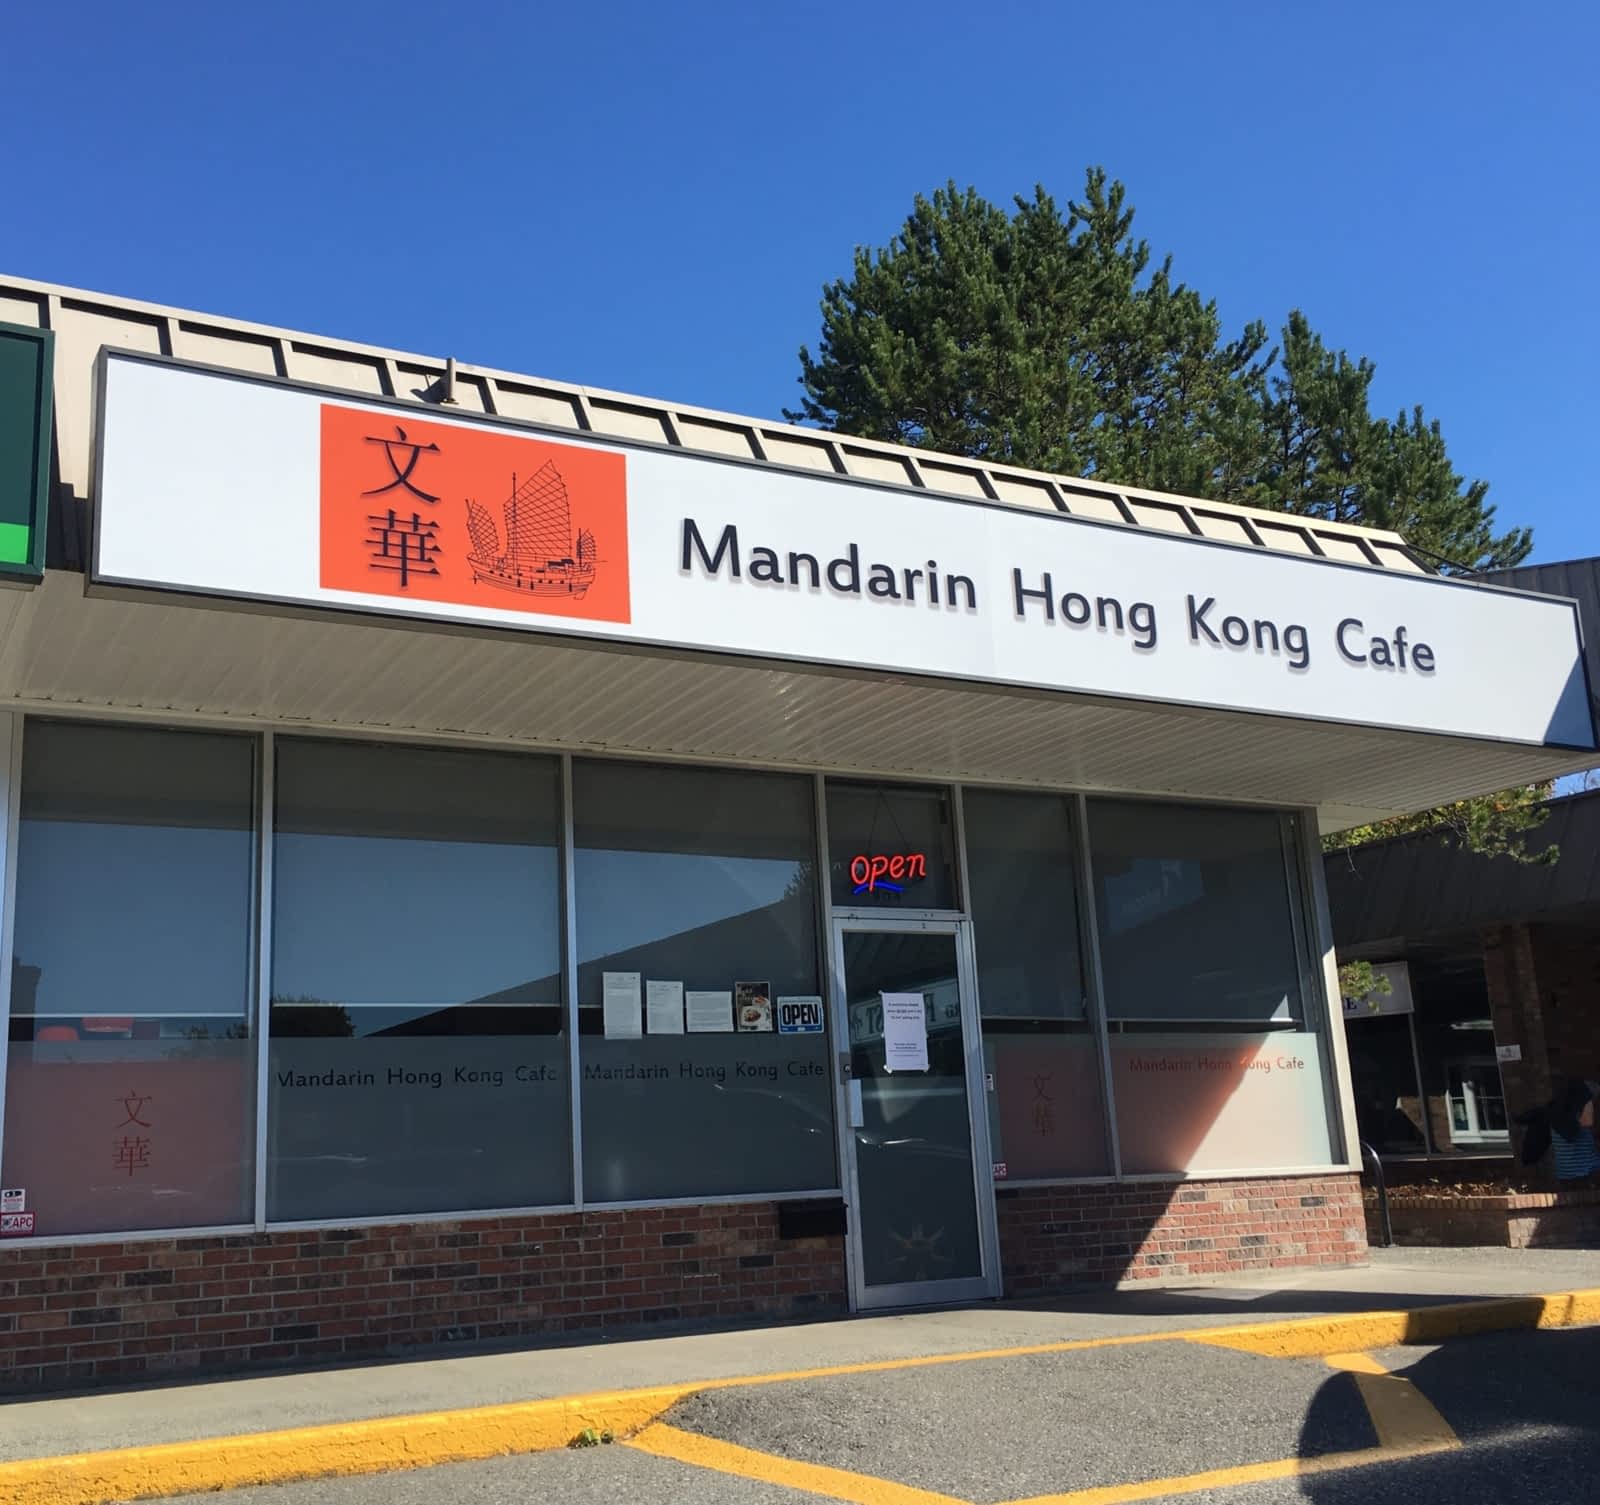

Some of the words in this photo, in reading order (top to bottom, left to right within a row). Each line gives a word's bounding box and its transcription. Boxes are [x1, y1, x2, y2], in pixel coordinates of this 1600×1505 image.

[360, 425, 442, 588] 文華
[680, 517, 977, 610] Mandarin
[1012, 567, 1158, 650] Hong
[1186, 594, 1310, 670] Kong
[1336, 617, 1436, 673] Cafe
[850, 853, 927, 892] Open
[782, 1003, 820, 1026] OPEN
[277, 1068, 375, 1088] Mandarin
[387, 1067, 443, 1089] Hong
[454, 1065, 504, 1088] Kong
[584, 1062, 670, 1081] Mandarin
[679, 1058, 727, 1082] Hong
[735, 1060, 778, 1081] Kong
[787, 1060, 825, 1077] Cafe
[1276, 1056, 1305, 1070] Cafe
[113, 1088, 153, 1177] 文華
